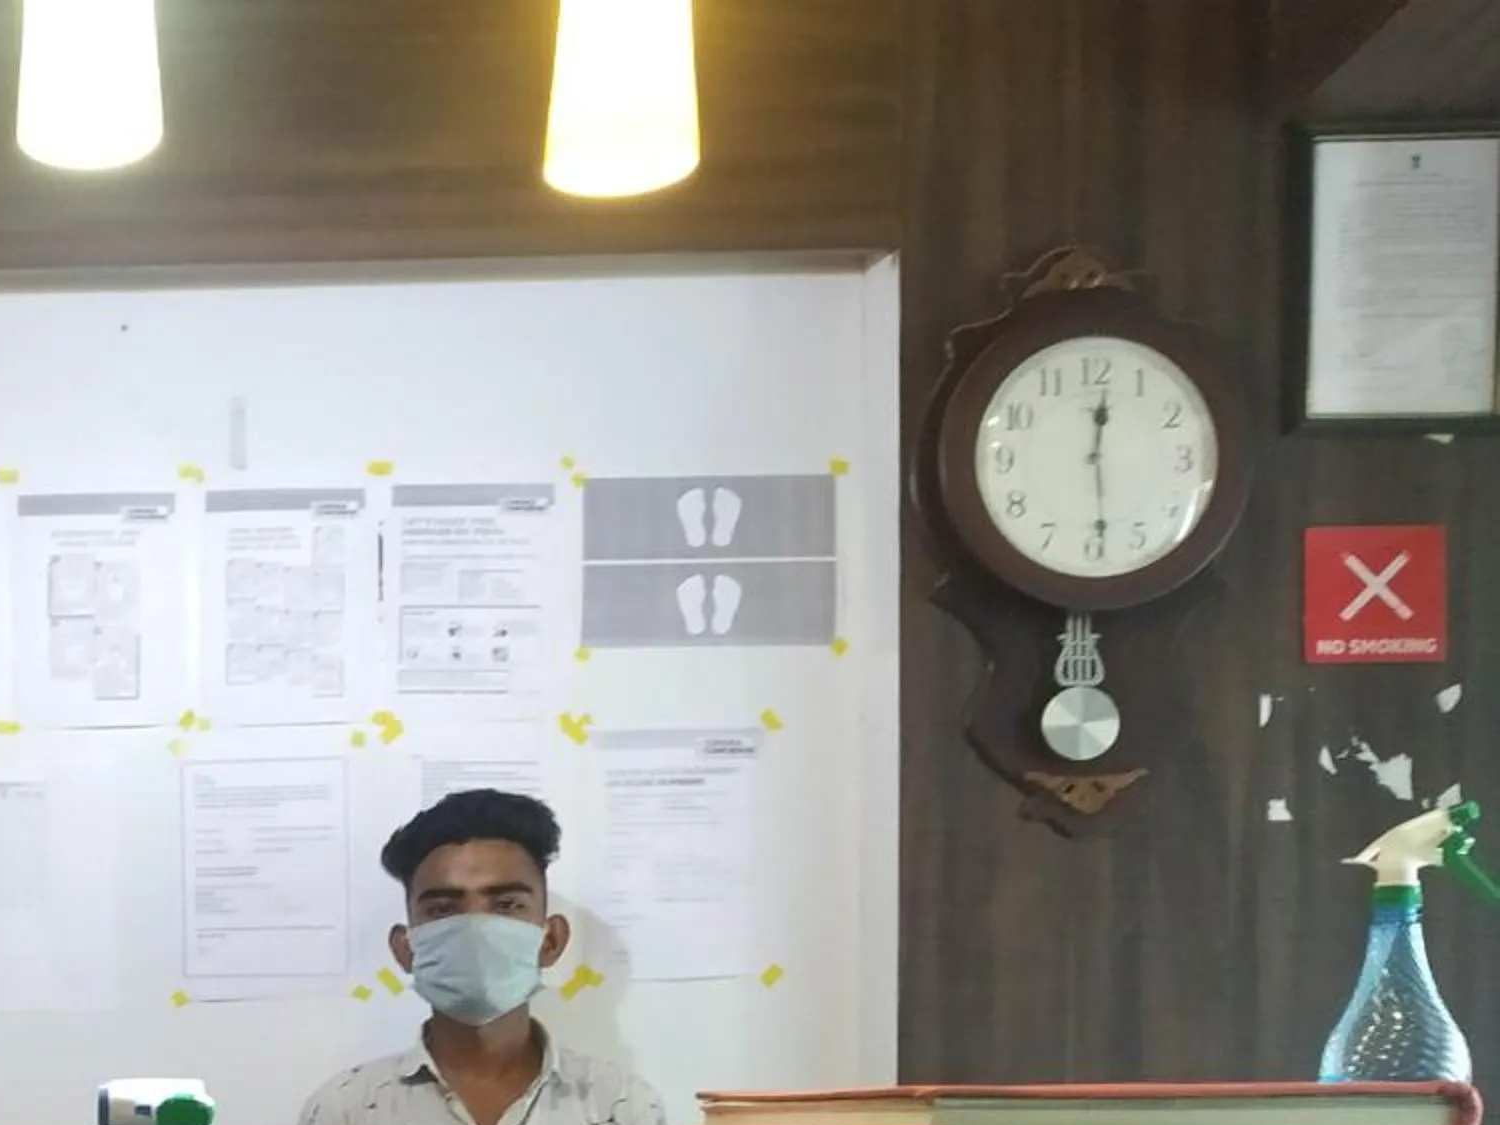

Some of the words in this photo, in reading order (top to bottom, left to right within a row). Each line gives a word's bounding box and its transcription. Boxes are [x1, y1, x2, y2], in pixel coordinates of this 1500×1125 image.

[1040, 367, 1062, 397] 11
[1079, 356, 1112, 387] 12
[1134, 367, 1146, 398] 1
[1005, 402, 1034, 431] 10
[1161, 400, 1182, 430] 2
[994, 447, 1015, 474] 9
[1173, 445, 1194, 473] 3
[1006, 489, 1027, 519] 8
[1039, 521, 1056, 551] 7
[1127, 520, 1147, 551] 5
[1315, 638, 1346, 655] NO
[1348, 637, 1439, 655] SMOKING
